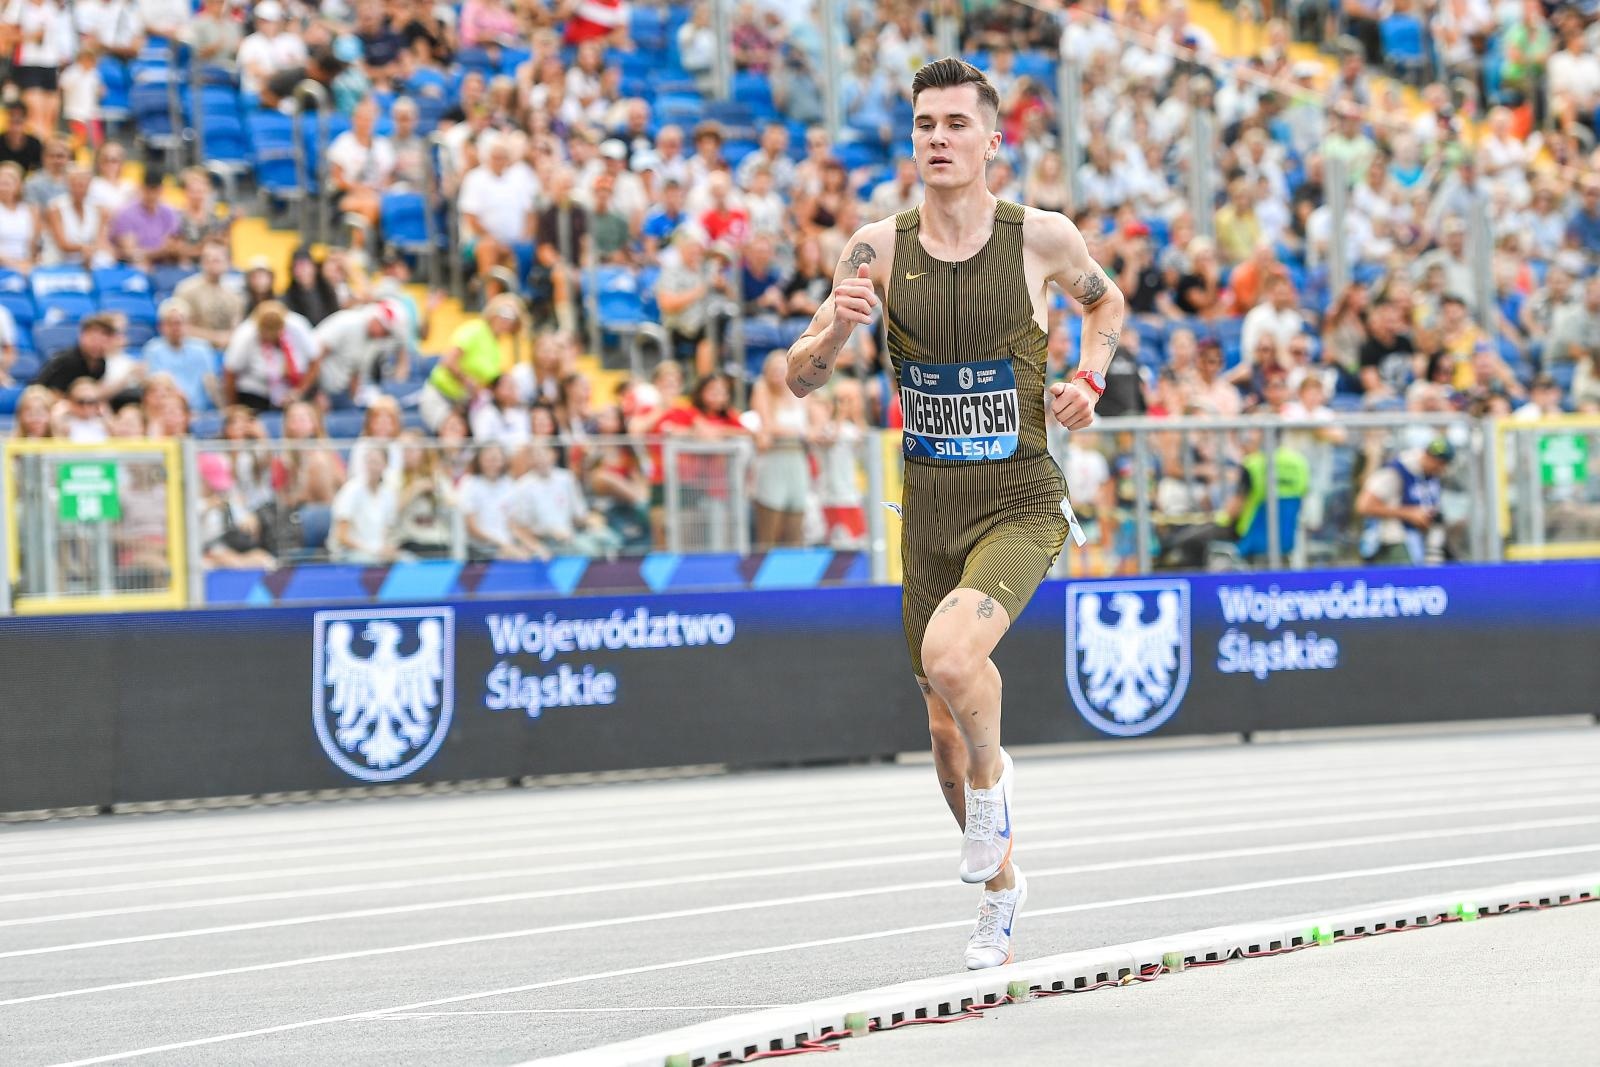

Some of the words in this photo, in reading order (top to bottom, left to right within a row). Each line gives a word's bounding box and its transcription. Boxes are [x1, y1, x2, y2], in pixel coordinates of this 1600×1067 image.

[904, 390, 1017, 435] INGEBRIGTSEN
[935, 441, 1003, 456] SILESIA
[1217, 579, 1448, 630] Województwo
[485, 607, 735, 661] Województwo
[1217, 628, 1338, 679] Śląskie
[485, 661, 617, 718] Śląskie
